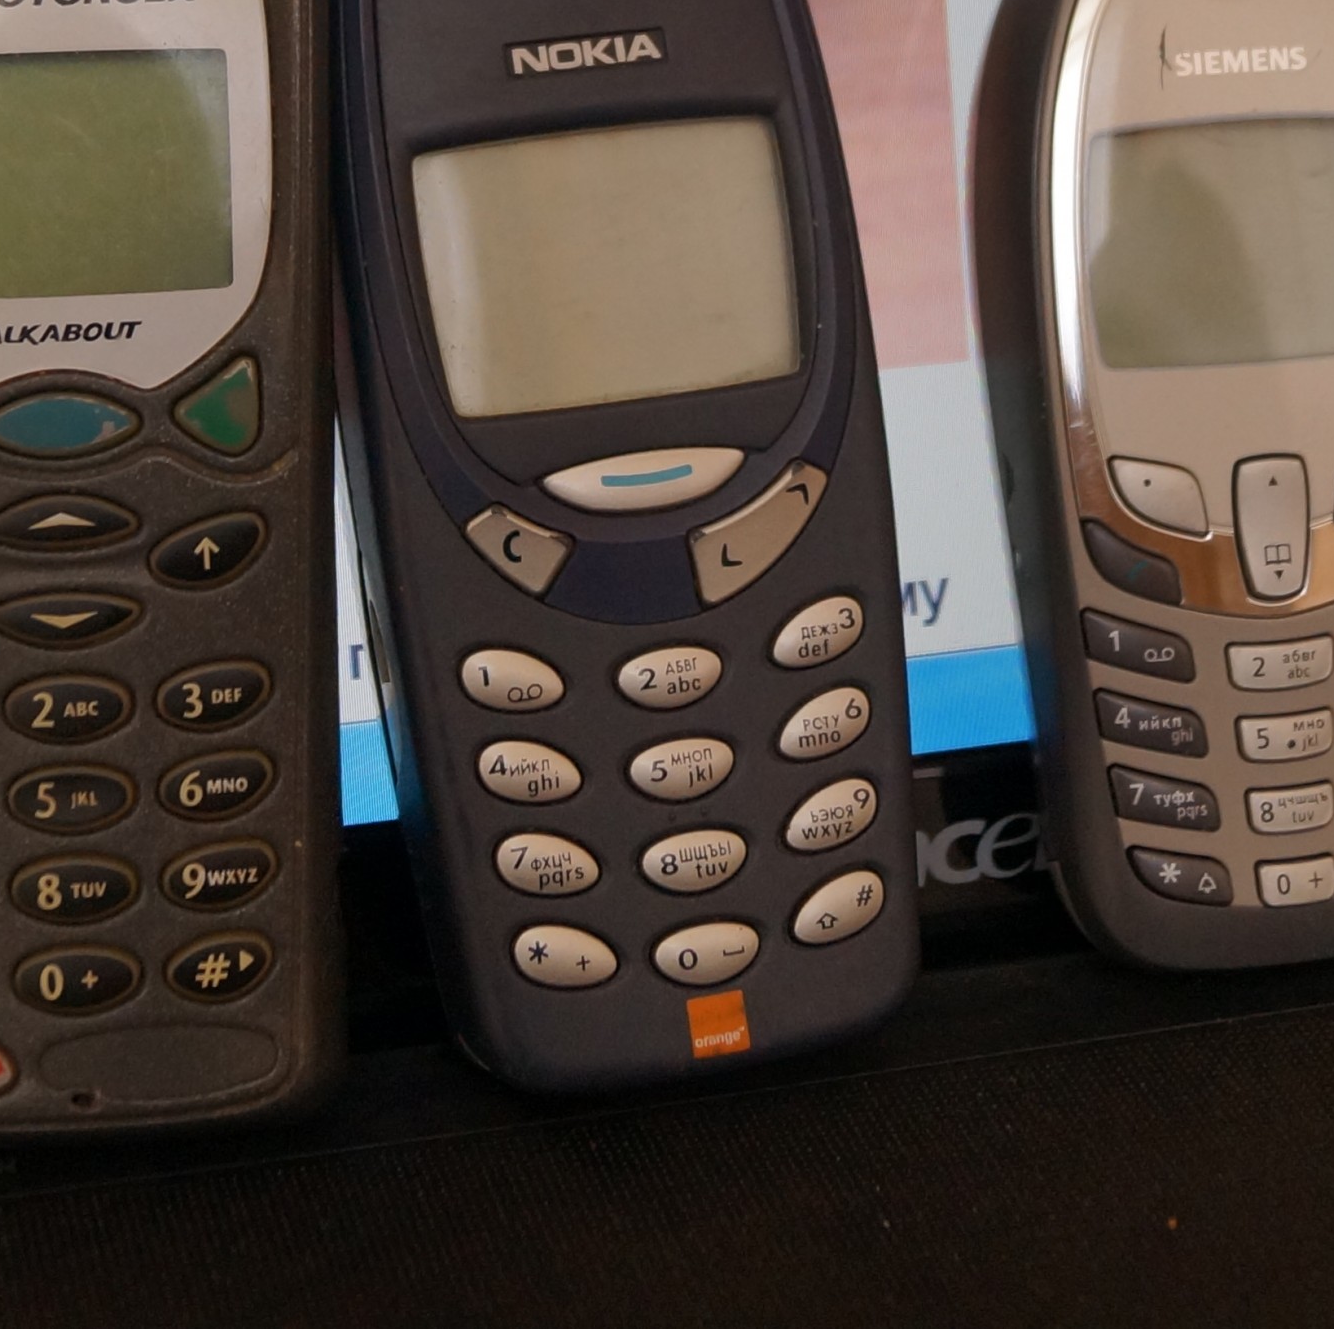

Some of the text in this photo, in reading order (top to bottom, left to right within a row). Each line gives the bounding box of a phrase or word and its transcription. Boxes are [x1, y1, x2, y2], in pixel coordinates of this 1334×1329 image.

[511, 32, 662, 75] NOKIA
[1174, 46, 1308, 77] SIEMENS
[838, 607, 856, 629] 3
[797, 639, 830, 659] def
[1108, 629, 1121, 652] 1
[637, 657, 698, 691] 2 АБВГ
[1252, 649, 1316, 678] 2 абвг
[1287, 663, 1311, 679] abc
[477, 666, 491, 687] 1
[666, 675, 702, 695] abc
[30, 691, 99, 729] 2 ABC
[181, 682, 243, 720] 3 DEF
[844, 697, 862, 720] 6
[1114, 705, 1131, 729] 4
[797, 727, 842, 748] mno
[1171, 727, 1194, 746] ghi
[1256, 728, 1270, 750] 5
[1301, 732, 1319, 752] jkl
[488, 754, 508, 777] 4
[650, 747, 714, 783] 5 МНОП
[687, 762, 714, 788] jkl
[178, 770, 249, 807] 6 MNO
[526, 772, 561, 797] ghi
[1129, 783, 1145, 806] 7
[35, 781, 99, 819] 5 JKL
[853, 788, 871, 810] 9
[1176, 803, 1209, 822] pqrs
[1260, 801, 1275, 823] 8
[1292, 809, 1315, 824] tuv
[801, 818, 855, 841] wxyz
[510, 846, 529, 870] 7
[660, 841, 732, 876] 8 ШЩЪЫ
[915, 811, 1048, 888] ce
[181, 862, 259, 900] 9 WXYZ
[538, 864, 585, 890] pqrs
[695, 859, 729, 880] tuv
[36, 873, 108, 911] 8 TUV
[1276, 873, 1291, 896] 0
[39, 964, 64, 1001] 0
[695, 1029, 741, 1048] orange
